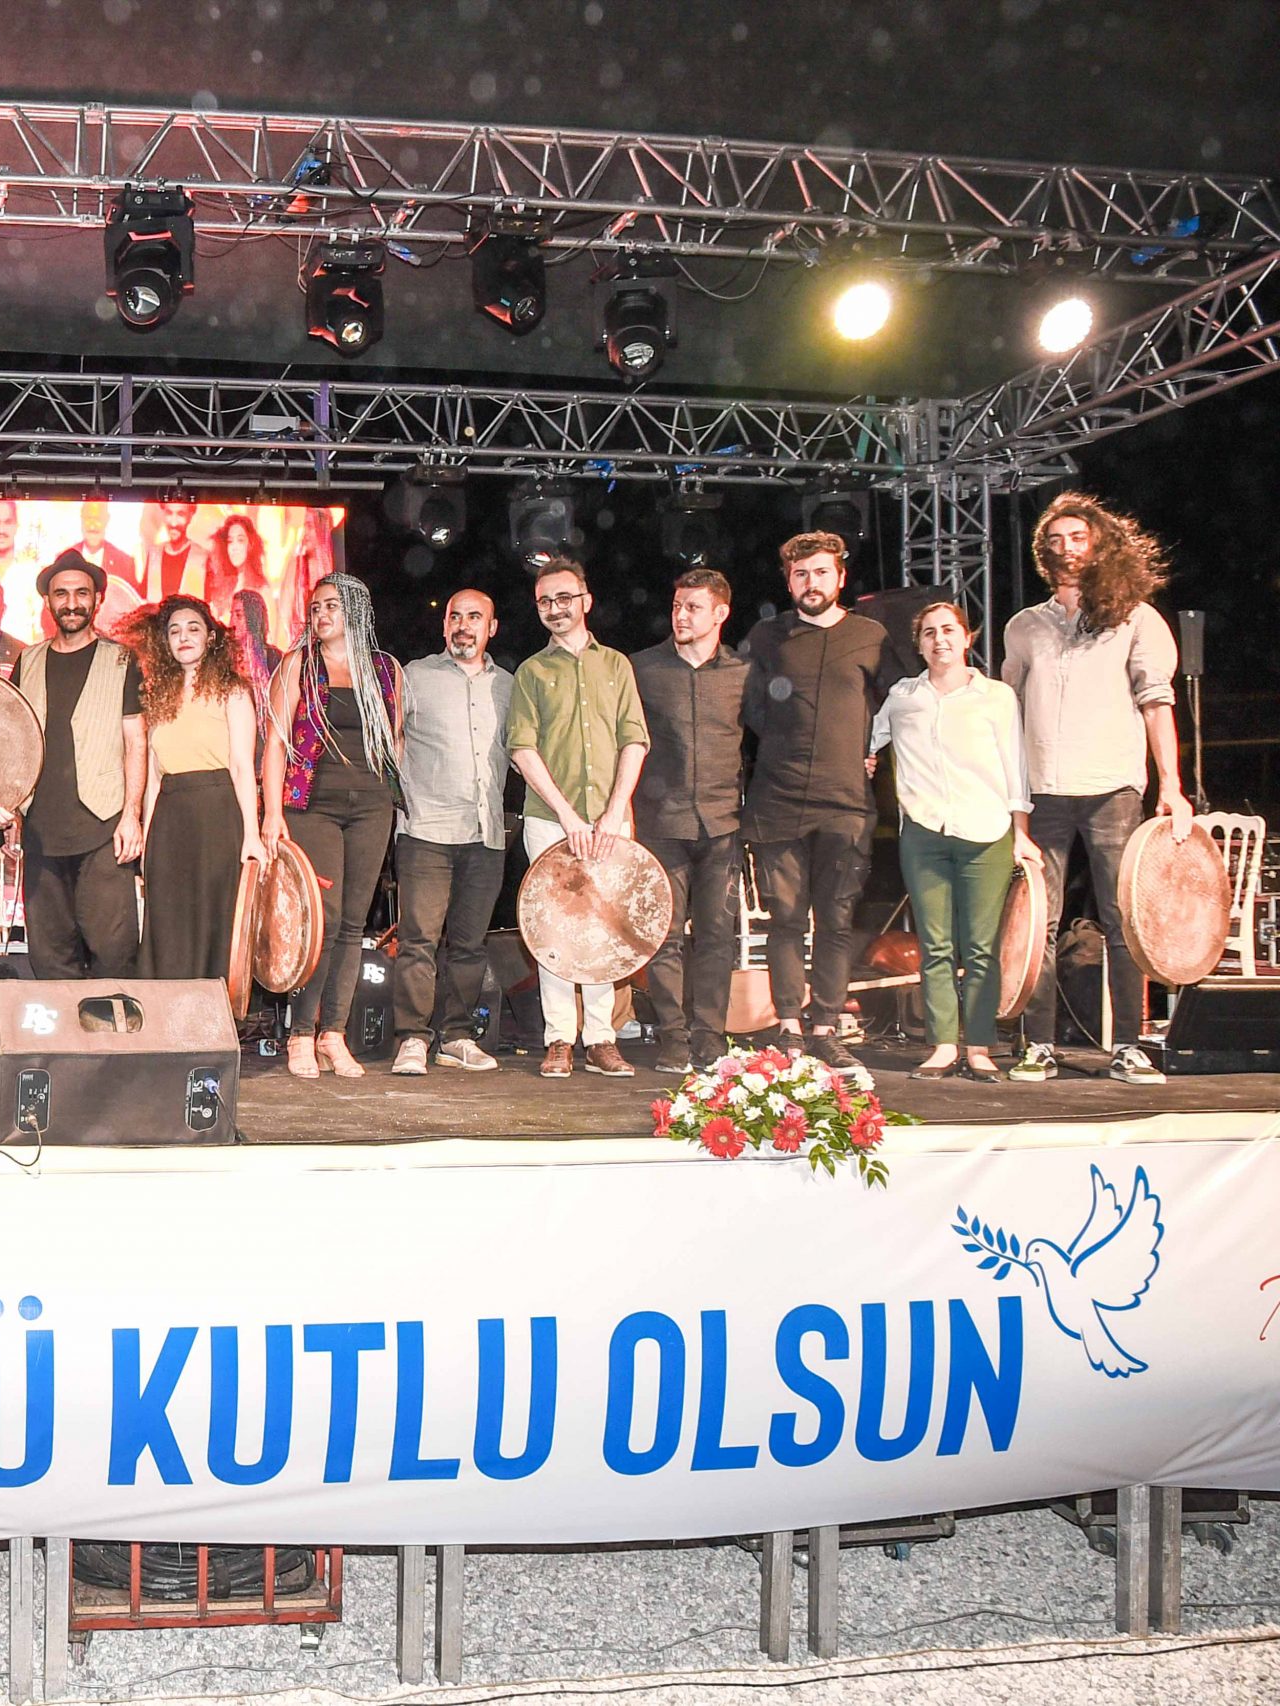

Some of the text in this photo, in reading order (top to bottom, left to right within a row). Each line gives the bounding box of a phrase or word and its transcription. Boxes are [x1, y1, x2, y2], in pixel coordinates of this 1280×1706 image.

[362, 963, 386, 984] RS
[21, 1003, 58, 1035] RS
[107, 1316, 559, 1486] KUTLU
[602, 1296, 1024, 1476] OLSUN
